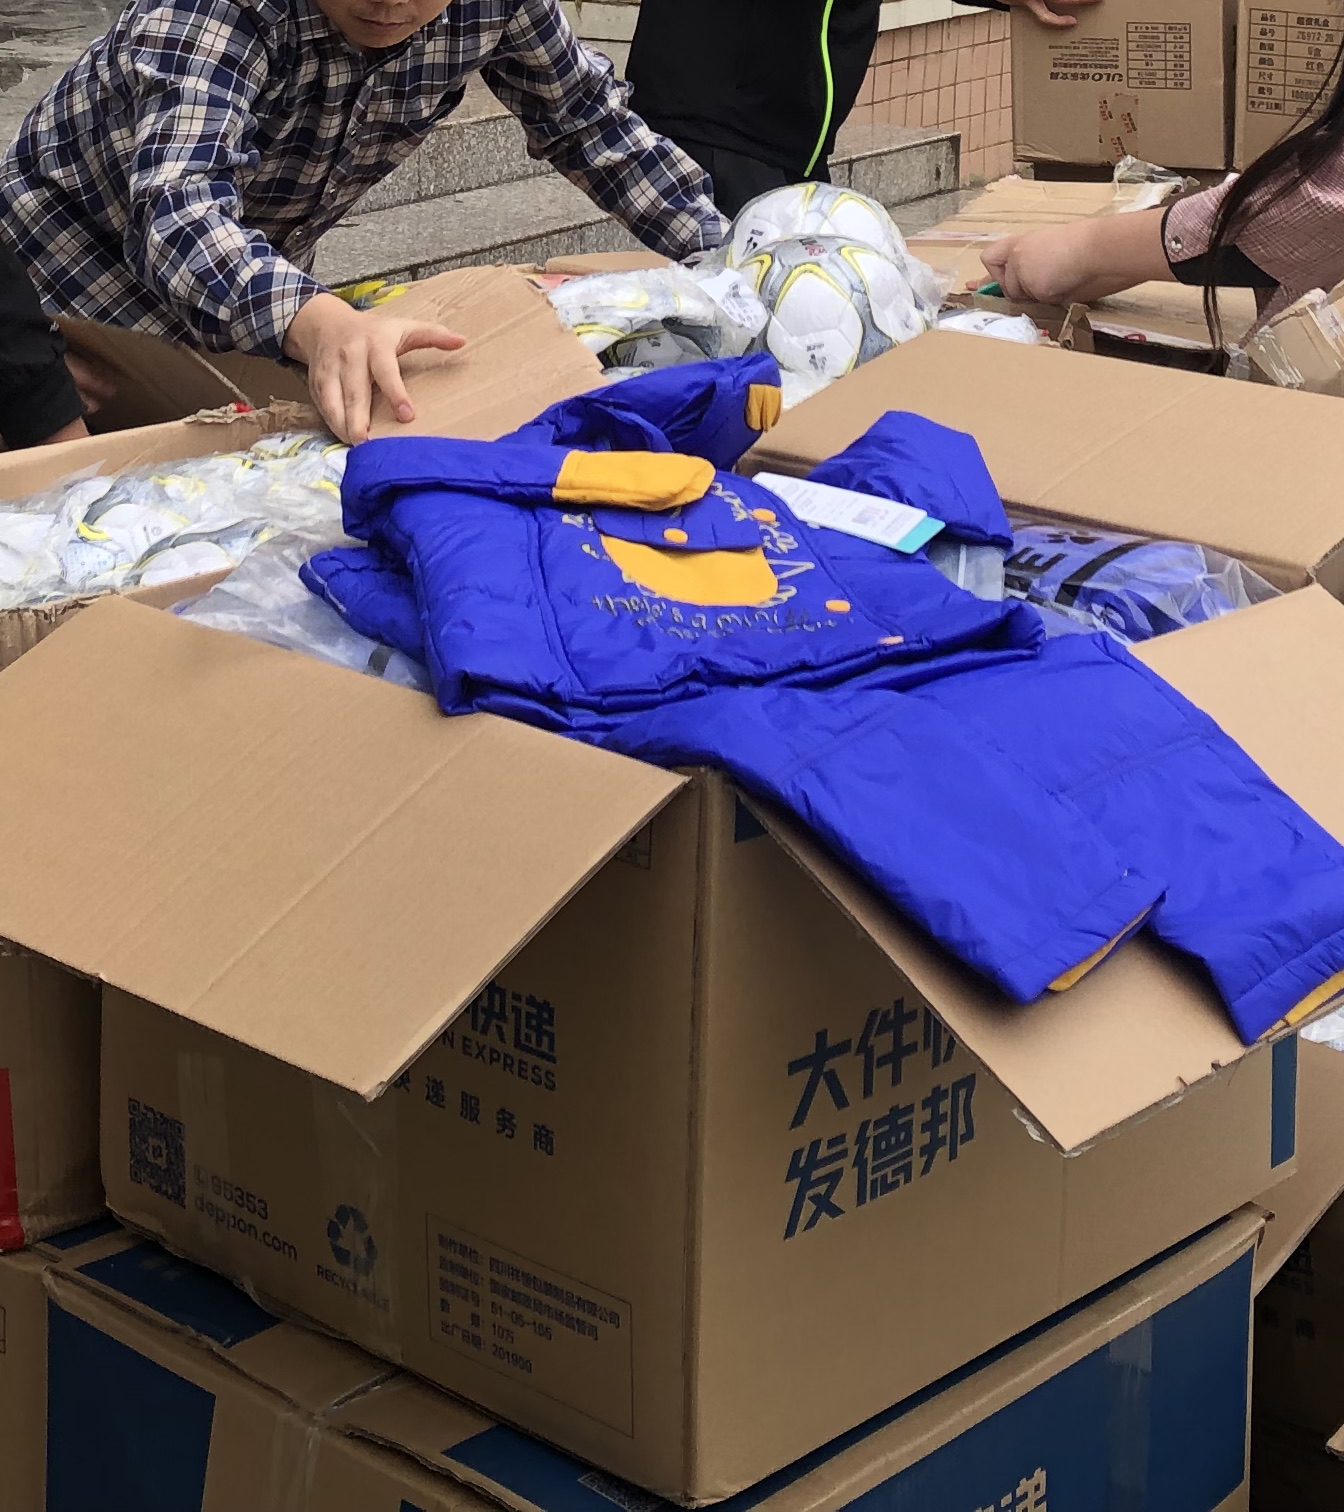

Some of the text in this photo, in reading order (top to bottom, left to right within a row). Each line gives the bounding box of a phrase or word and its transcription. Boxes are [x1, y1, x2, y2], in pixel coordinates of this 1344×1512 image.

[461, 1036, 557, 1092] EXPRESS
[784, 1072, 976, 1241] 发德邦
[194, 1192, 298, 1263] deppon.com
